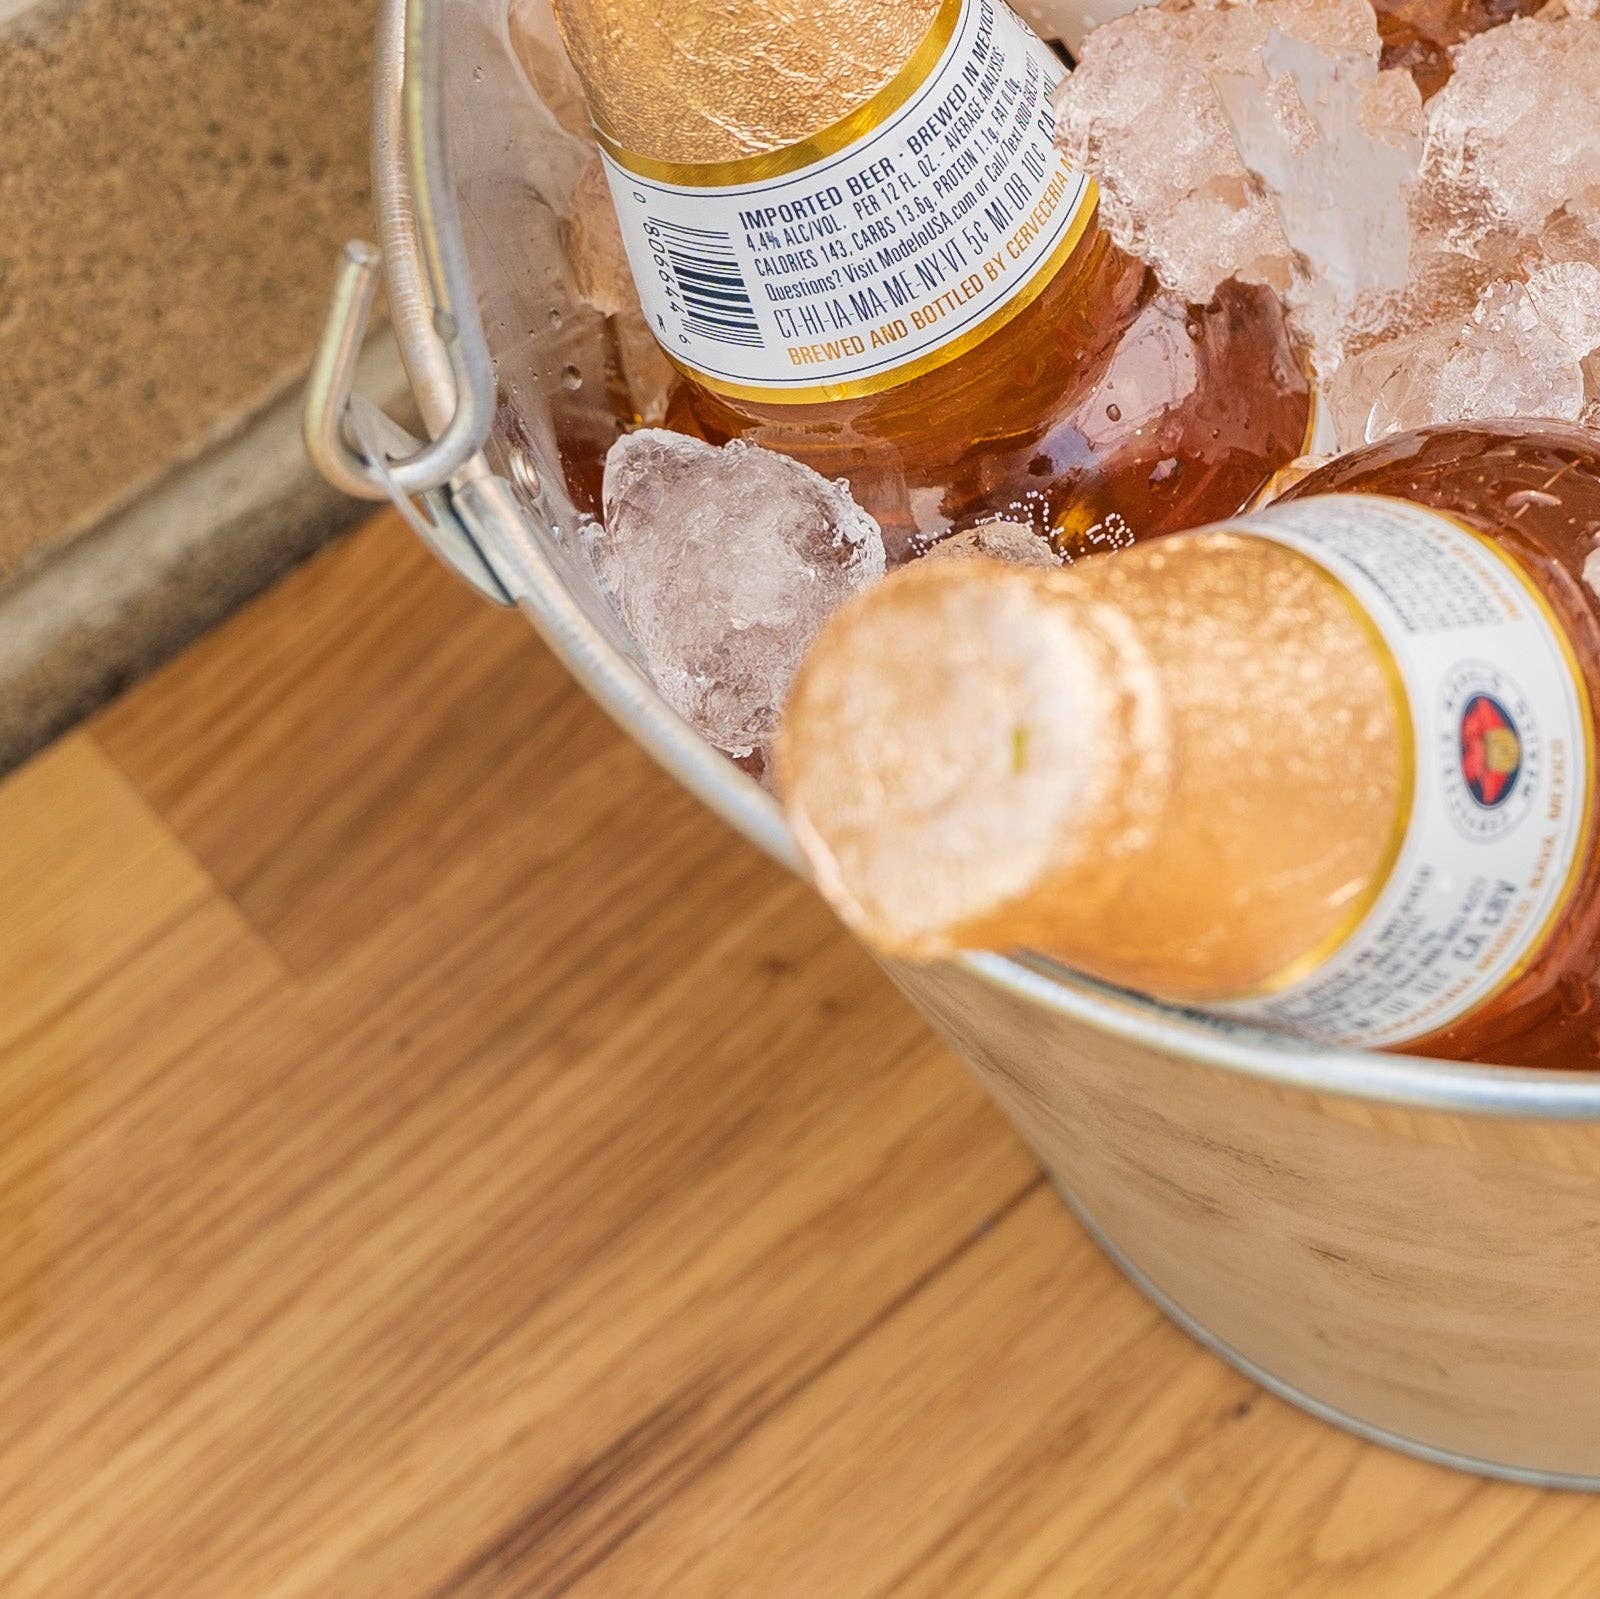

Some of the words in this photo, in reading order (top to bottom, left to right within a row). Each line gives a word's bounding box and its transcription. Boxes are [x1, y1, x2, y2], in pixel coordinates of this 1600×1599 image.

[738, 186, 844, 231] IMPORTED
[845, 156, 897, 198] BEER
[906, 83, 968, 157] BREWED
[961, 60, 981, 88] IN
[745, 231, 782, 253] 4.4%
[783, 213, 847, 248] ALC/VOL.
[852, 193, 882, 221] PER
[880, 182, 901, 206] 12
[898, 171, 922, 194] FL.
[917, 153, 942, 179] OZ.
[944, 96, 985, 154] AVERAGE
[754, 248, 819, 278] CALORIES
[820, 239, 854, 264] 143,
[851, 215, 897, 252] CARBS
[932, 147, 980, 201] PROTEIN
[990, 98, 1010, 128] FAT
[764, 268, 845, 302] Questions?
[842, 256, 880, 285] Visit
[876, 190, 978, 270] ModeloUSA.com
[974, 176, 989, 198] or
[984, 125, 1024, 184] Call/Text
[773, 237, 968, 339] CT-HI-IA-MA-ME-NY-VT
[984, 171, 1033, 234] MI-OR
[787, 334, 866, 366] BREWED
[870, 318, 910, 349] AND
[910, 273, 985, 331] BOTTLED
[983, 250, 1007, 282] BY
[1006, 170, 1069, 261] CERVECERIA
